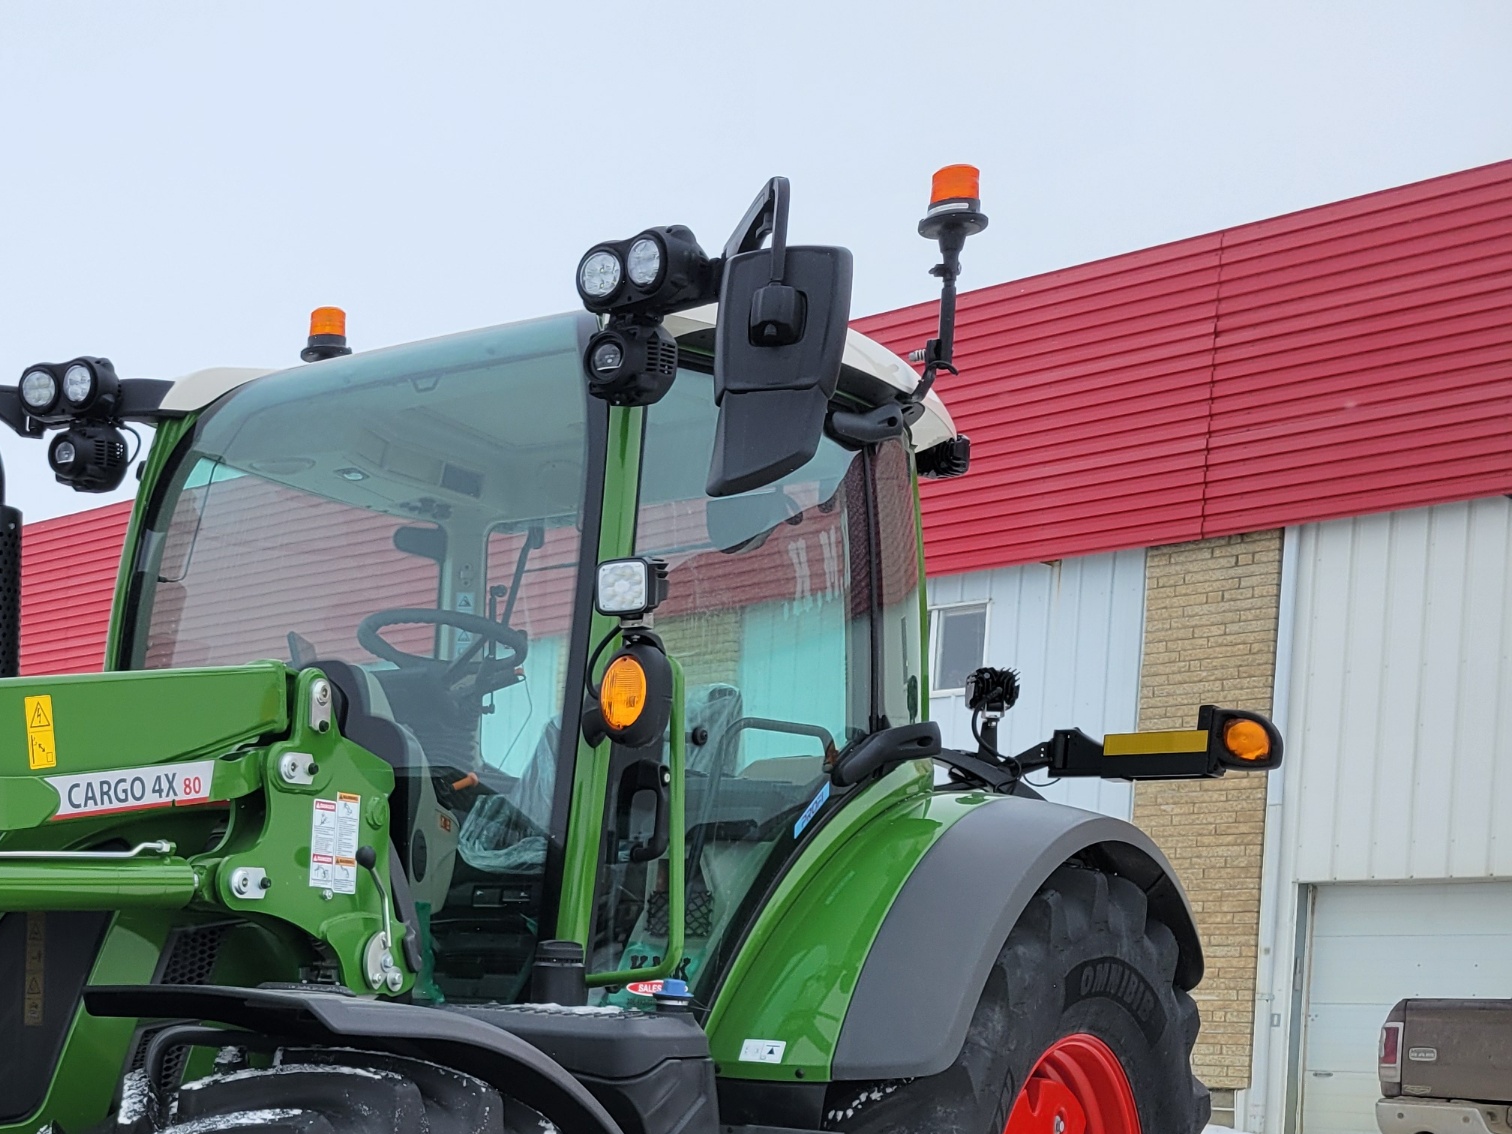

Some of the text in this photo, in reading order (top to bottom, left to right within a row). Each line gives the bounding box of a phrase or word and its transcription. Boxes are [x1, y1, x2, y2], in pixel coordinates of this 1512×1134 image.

[67, 772, 202, 809] CARGO 4X 80
[638, 984, 663, 994] SALES
[1080, 962, 1155, 1022] OMNIBIB
